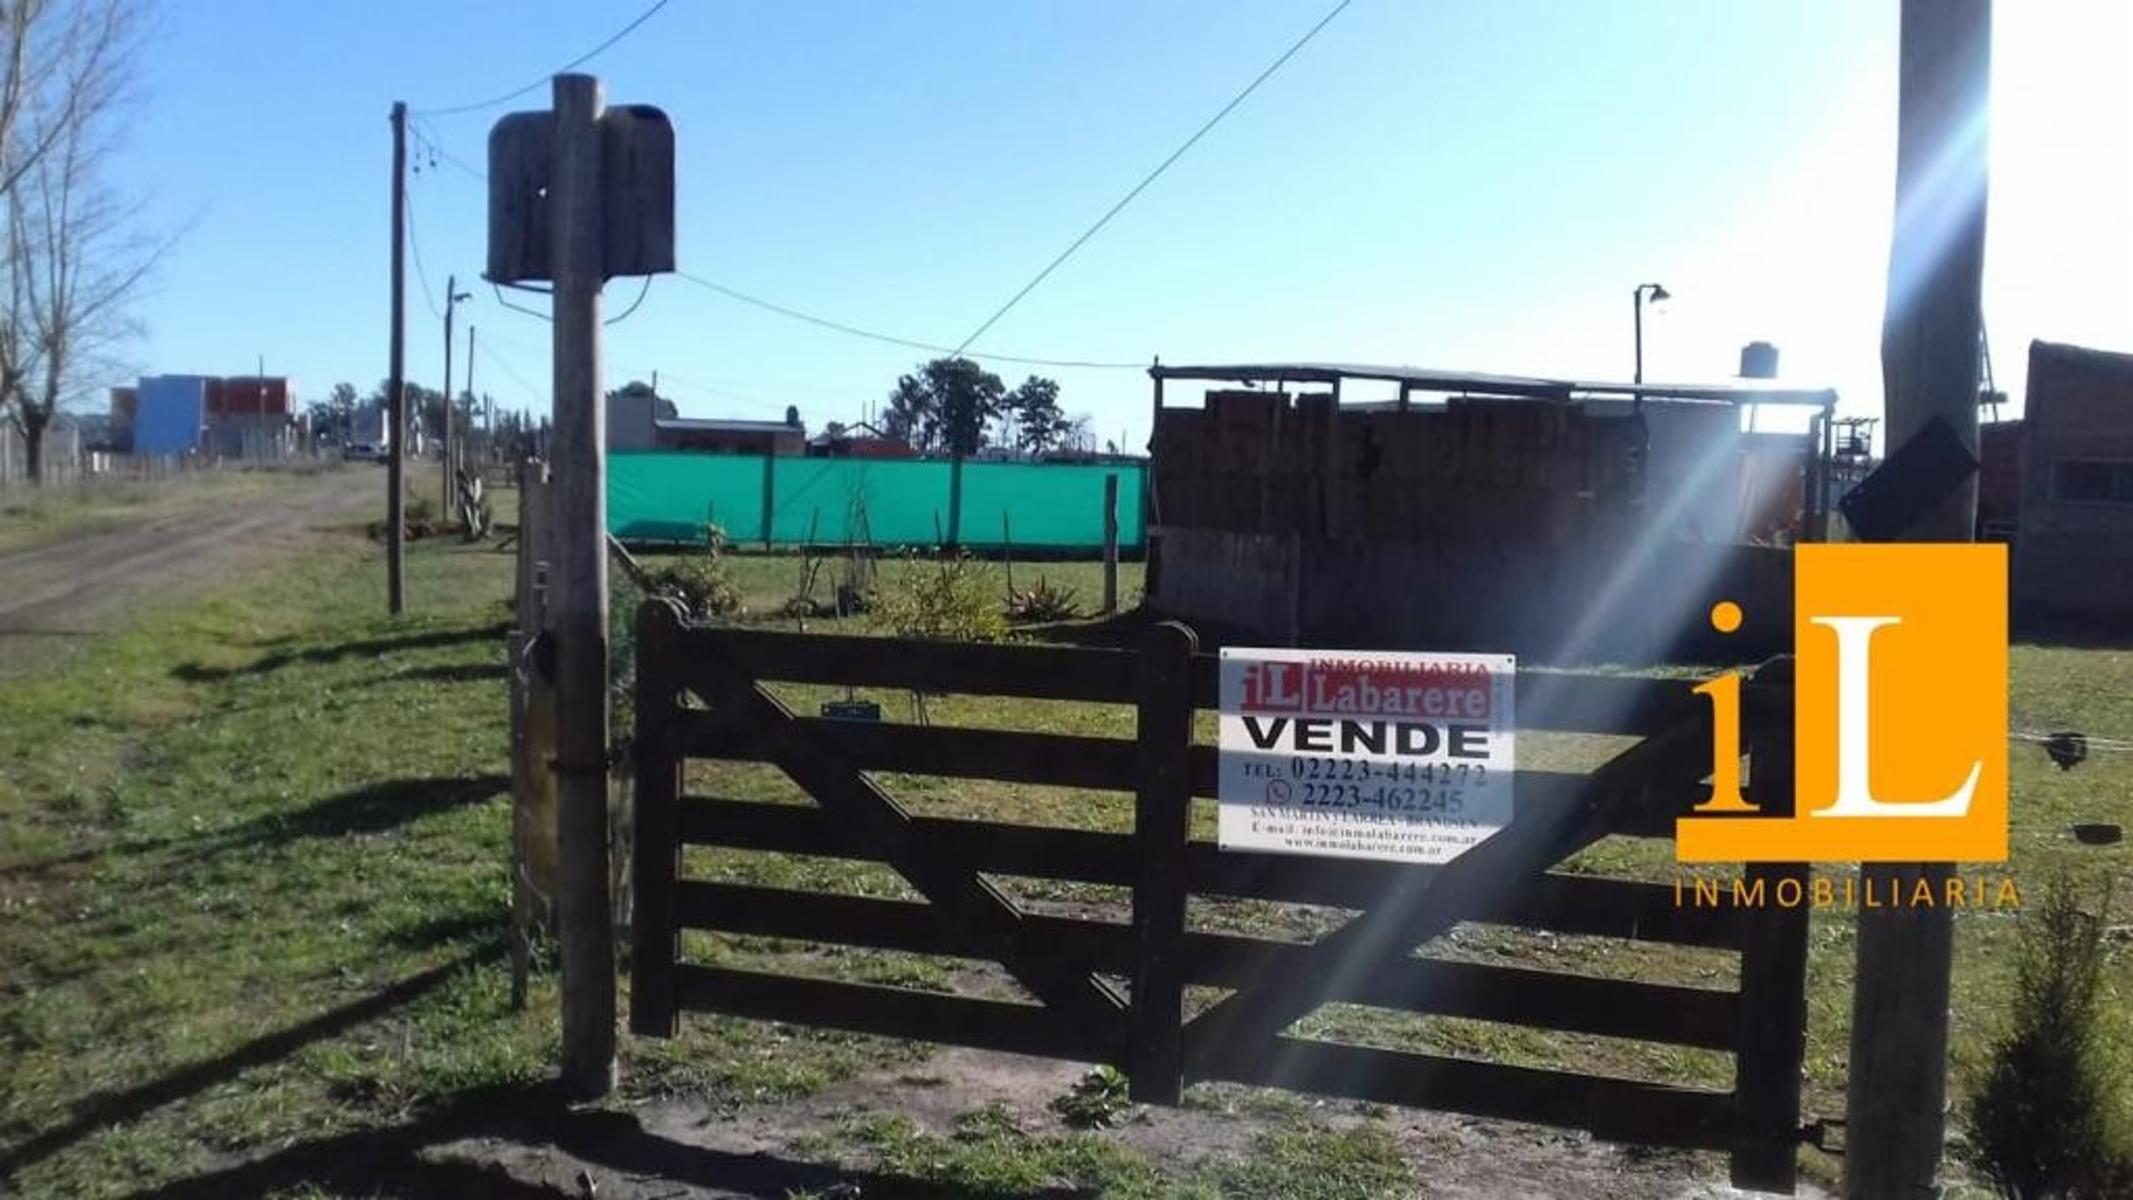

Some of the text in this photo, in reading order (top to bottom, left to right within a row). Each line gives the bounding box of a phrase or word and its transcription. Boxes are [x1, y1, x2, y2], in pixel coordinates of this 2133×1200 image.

[1311, 657, 1489, 676] INMOBILIARIA
[1312, 674, 1488, 718] Labarere
[1242, 715, 1490, 759] VENDE
[1292, 756, 1487, 788] 02223-444272
[1303, 783, 1465, 813] 2223-462245
